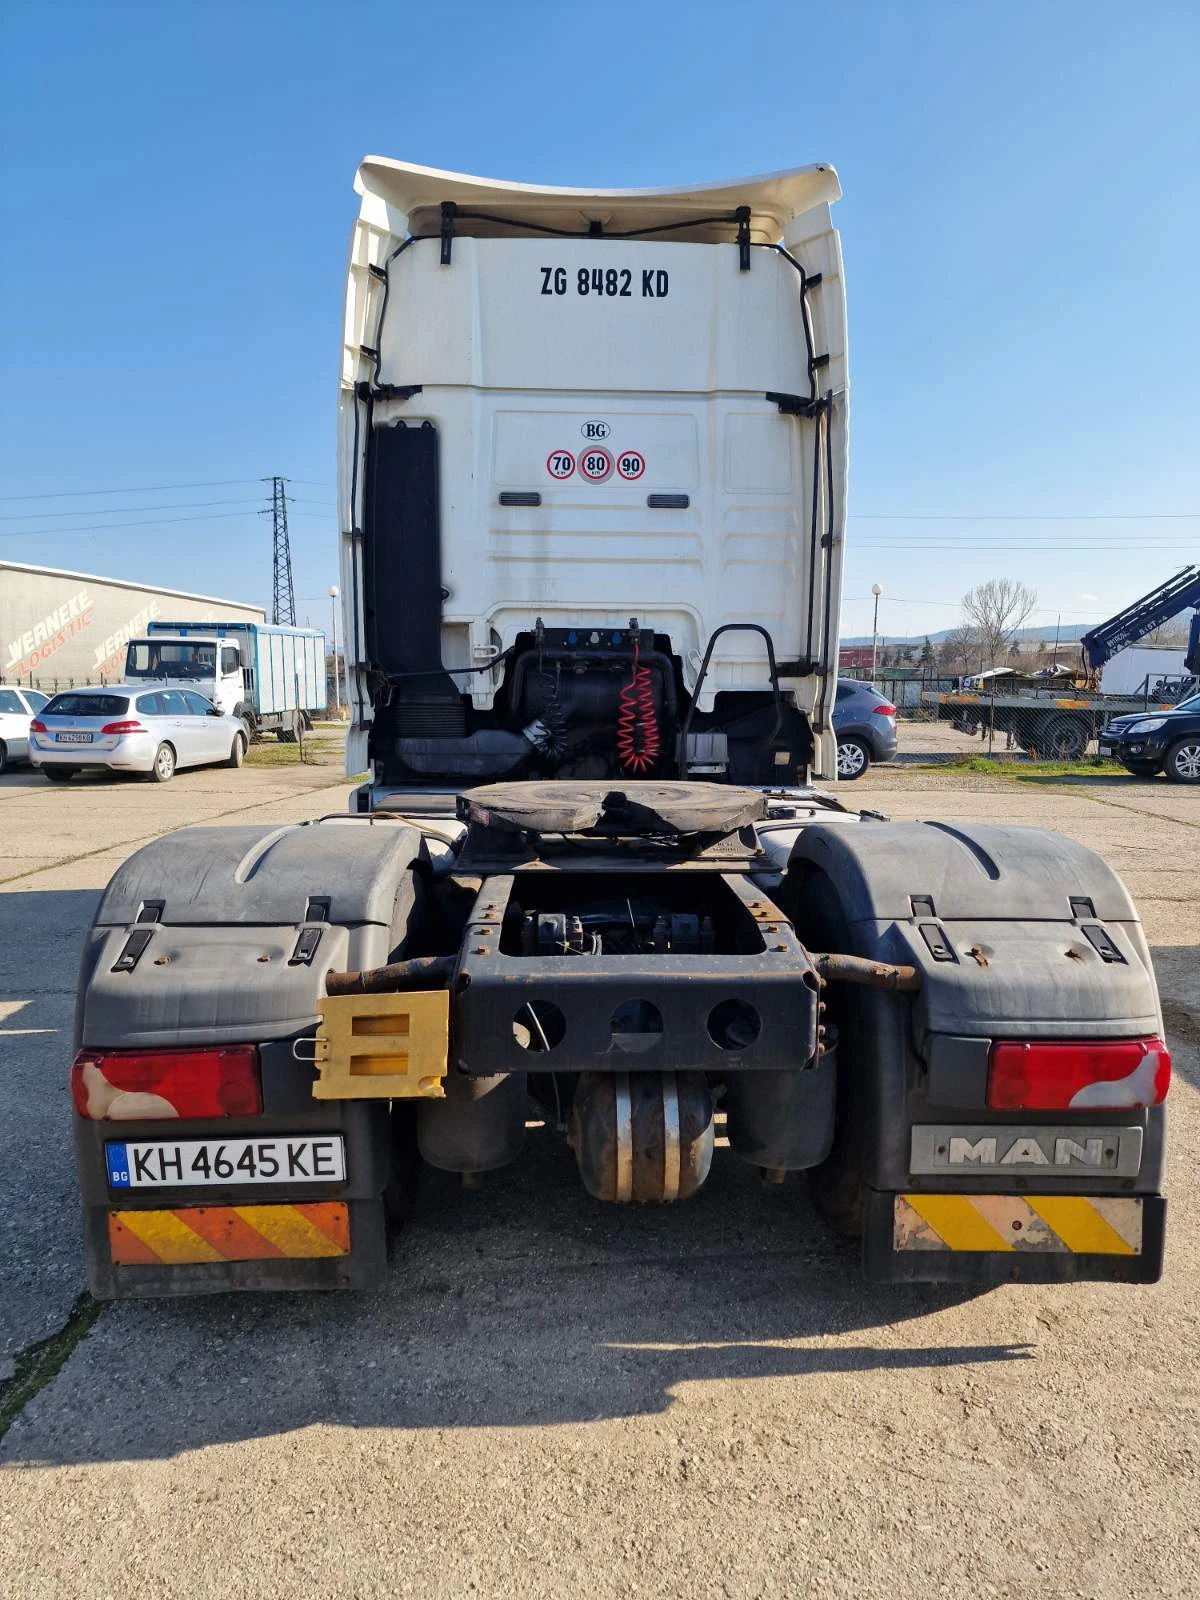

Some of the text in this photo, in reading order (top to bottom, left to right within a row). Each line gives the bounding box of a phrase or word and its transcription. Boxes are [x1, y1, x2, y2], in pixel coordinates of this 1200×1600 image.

[540, 267, 669, 298] ZG 8482 KD
[586, 423, 607, 438] BG
[553, 456, 571, 471] 70
[587, 456, 605, 471] 80
[622, 458, 640, 472] 90
[6, 589, 93, 668] WERNEKE
[17, 613, 93, 676] LOGISTIC
[948, 1136, 1104, 1165] MAN
[133, 1142, 336, 1182] KH 4645 KE
[112, 1171, 128, 1182] BG
